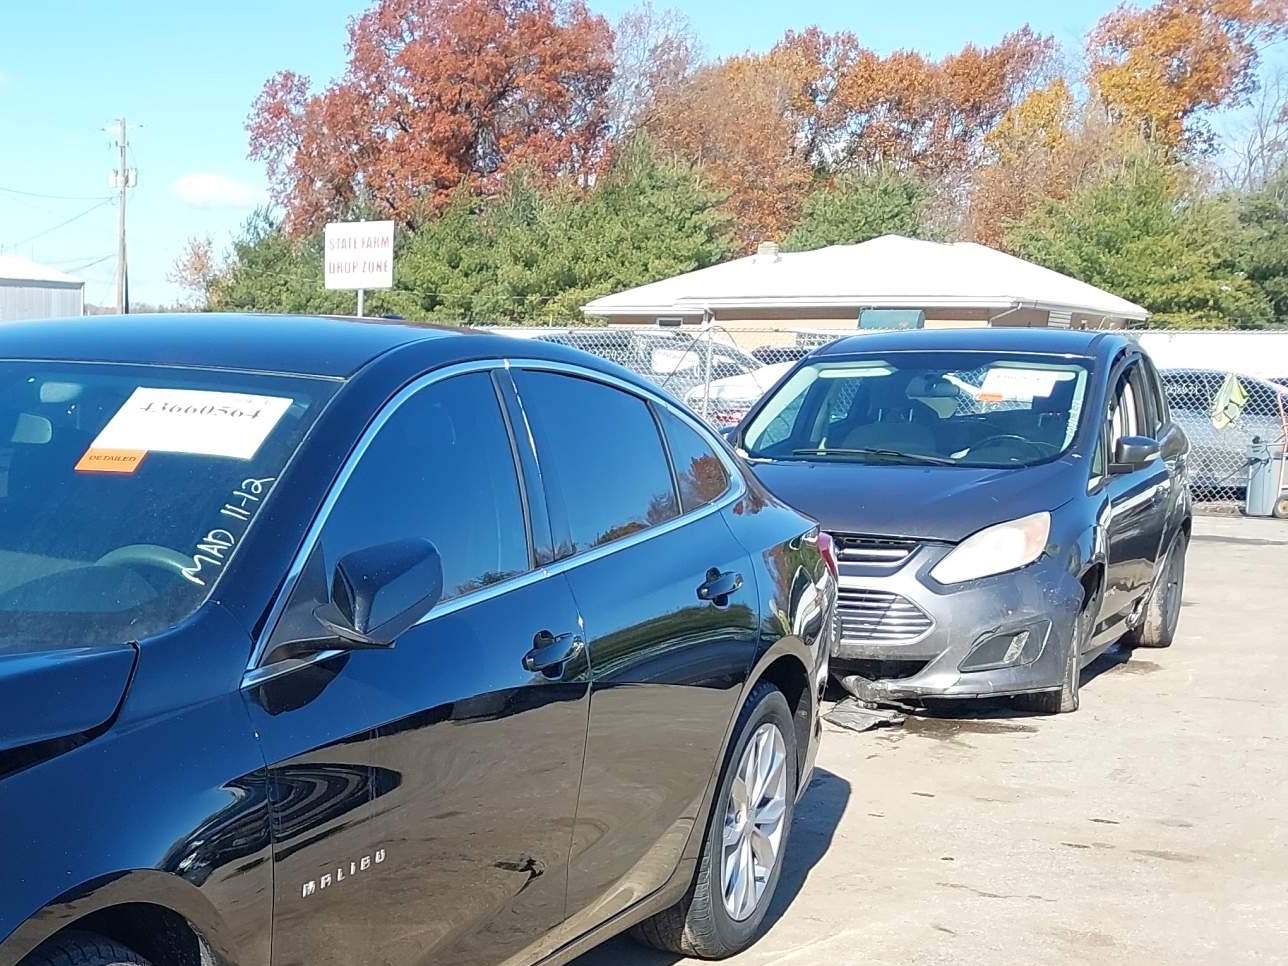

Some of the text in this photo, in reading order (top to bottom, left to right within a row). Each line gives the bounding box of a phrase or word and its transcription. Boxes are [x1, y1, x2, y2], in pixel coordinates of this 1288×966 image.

[329, 236, 390, 250] STATE FARM
[329, 260, 388, 273] DROP ZONE
[89, 454, 137, 462] DETAILED
[220, 478, 276, 521] 11-12
[302, 849, 386, 898] MALIBU
